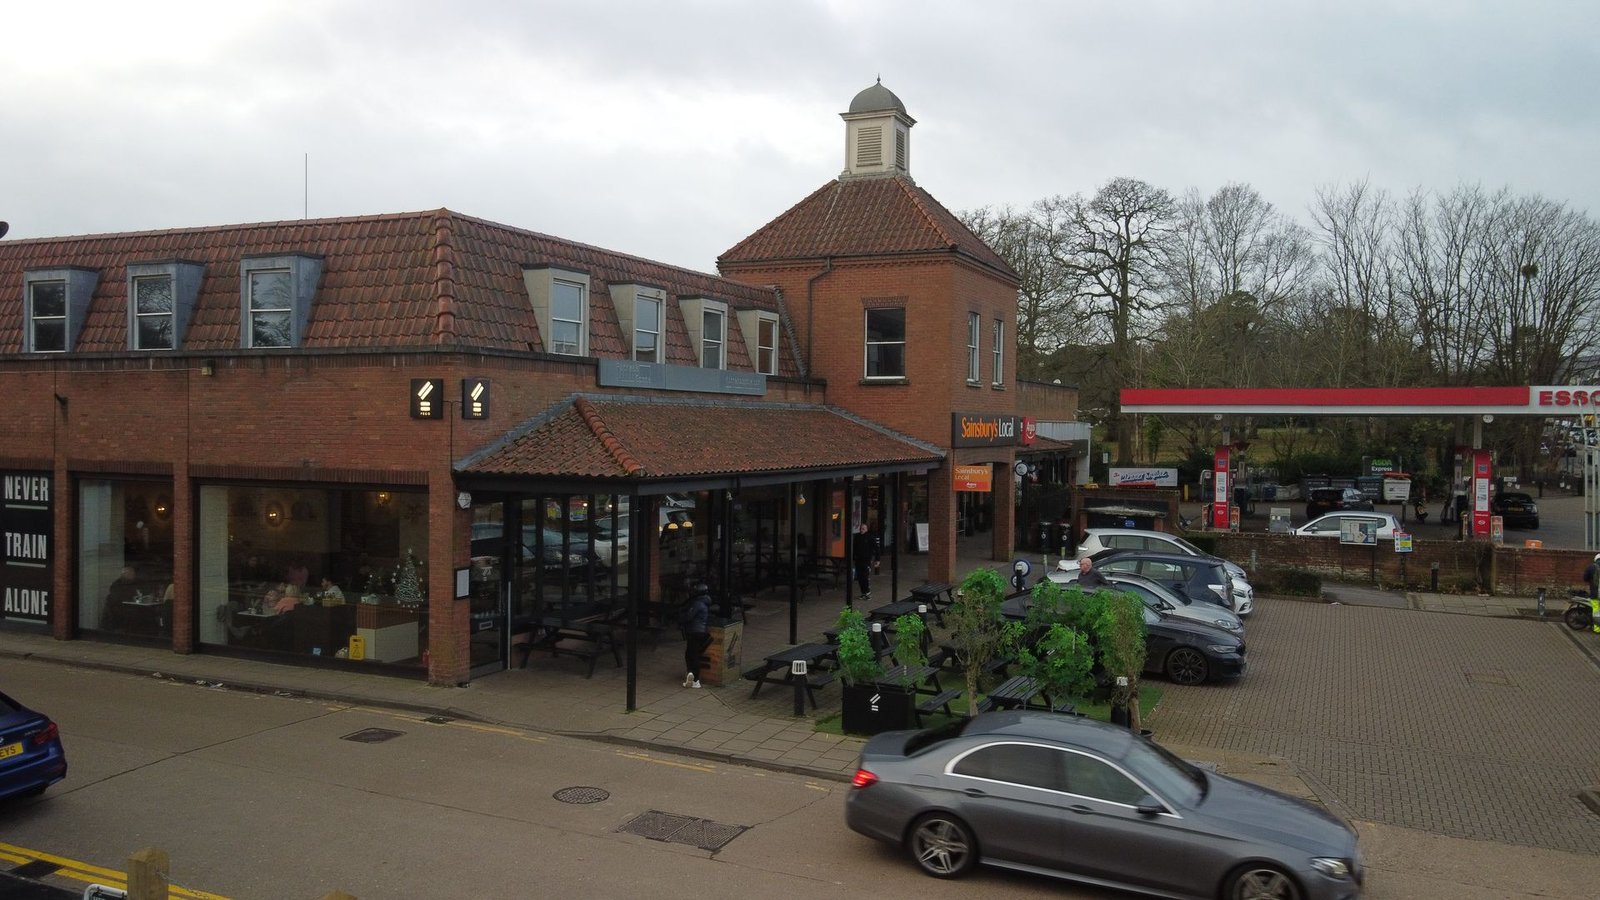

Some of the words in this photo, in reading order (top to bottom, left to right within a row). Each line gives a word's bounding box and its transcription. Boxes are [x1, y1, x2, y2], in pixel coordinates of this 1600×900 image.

[962, 417, 998, 441] Sainsbury's
[999, 417, 1014, 437] Local
[955, 467, 988, 475] Sainsbury's
[5, 476, 48, 501] NEVER
[5, 532, 47, 559] TRAIN
[4, 587, 48, 615] ALONE
